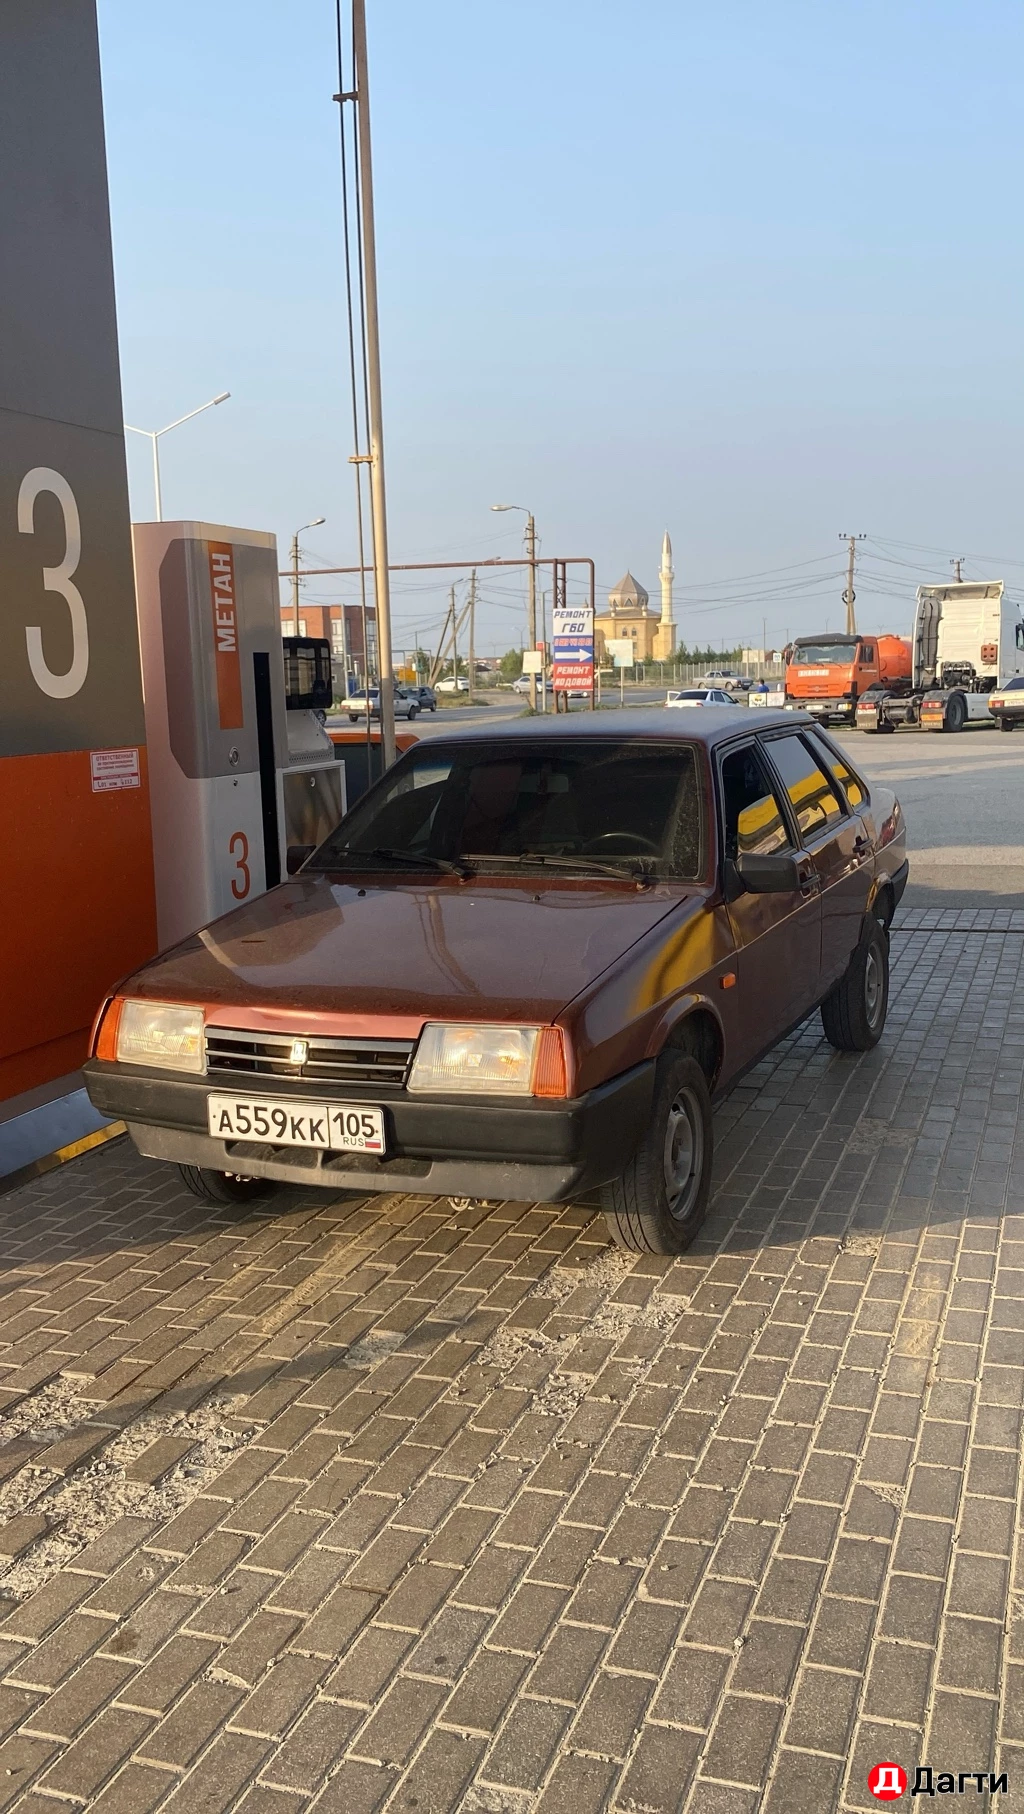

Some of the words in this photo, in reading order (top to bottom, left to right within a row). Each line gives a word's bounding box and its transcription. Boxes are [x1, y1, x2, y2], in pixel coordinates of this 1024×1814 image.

[17, 466, 89, 699] 3
[211, 552, 236, 651] МЕТАН
[554, 610, 592, 618] РЕМОНТ
[562, 623, 585, 632] ГБО
[556, 666, 590, 675] РЕМОНТ
[229, 831, 250, 900] 3
[218, 1104, 325, 1143] А559КК
[332, 1112, 375, 1138] 105
[343, 1136, 365, 1147] RUS
